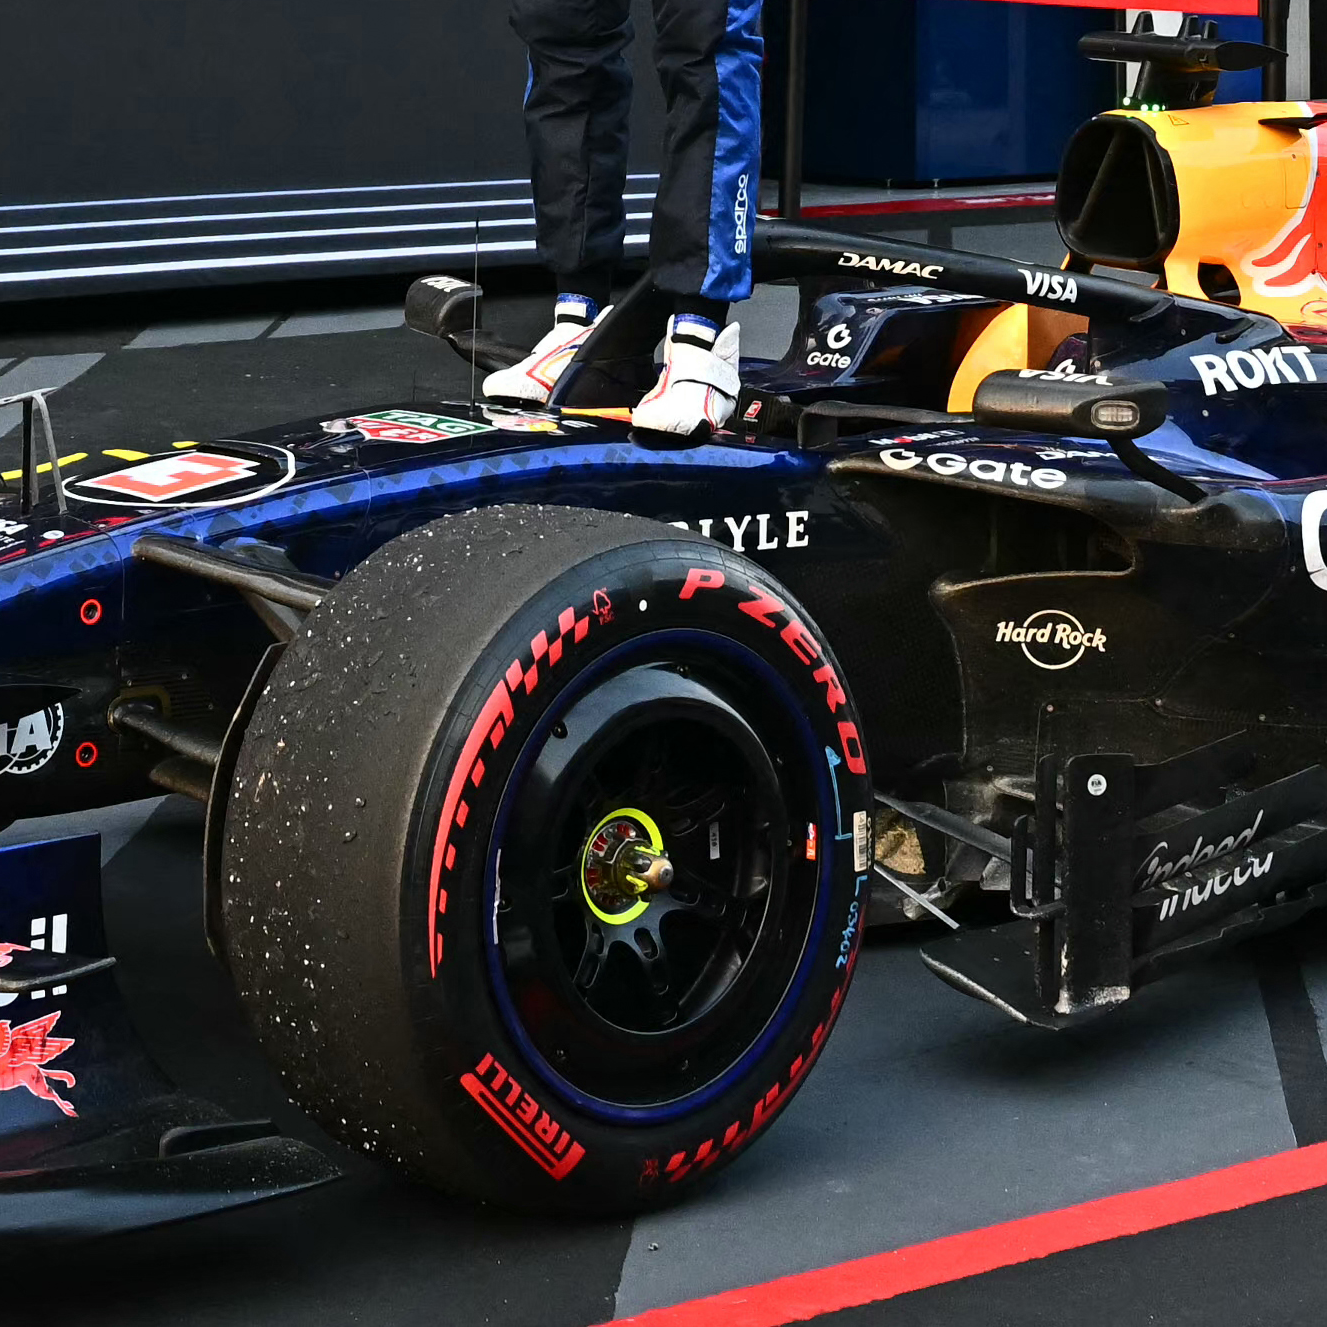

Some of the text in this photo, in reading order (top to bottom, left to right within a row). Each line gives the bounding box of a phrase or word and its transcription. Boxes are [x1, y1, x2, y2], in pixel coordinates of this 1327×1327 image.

[734, 173, 748, 254] sparco
[838, 252, 944, 279] DAMAC
[1017, 268, 1078, 304] VISA
[807, 351, 851, 368] Gate
[1189, 345, 1317, 396] ROKT
[382, 412, 476, 432] TAG
[927, 452, 1067, 490] Gate
[996, 621, 1107, 652] Hard Rock
[678, 568, 868, 775] P ZERO
[460, 1053, 586, 1181] PIRELLI
